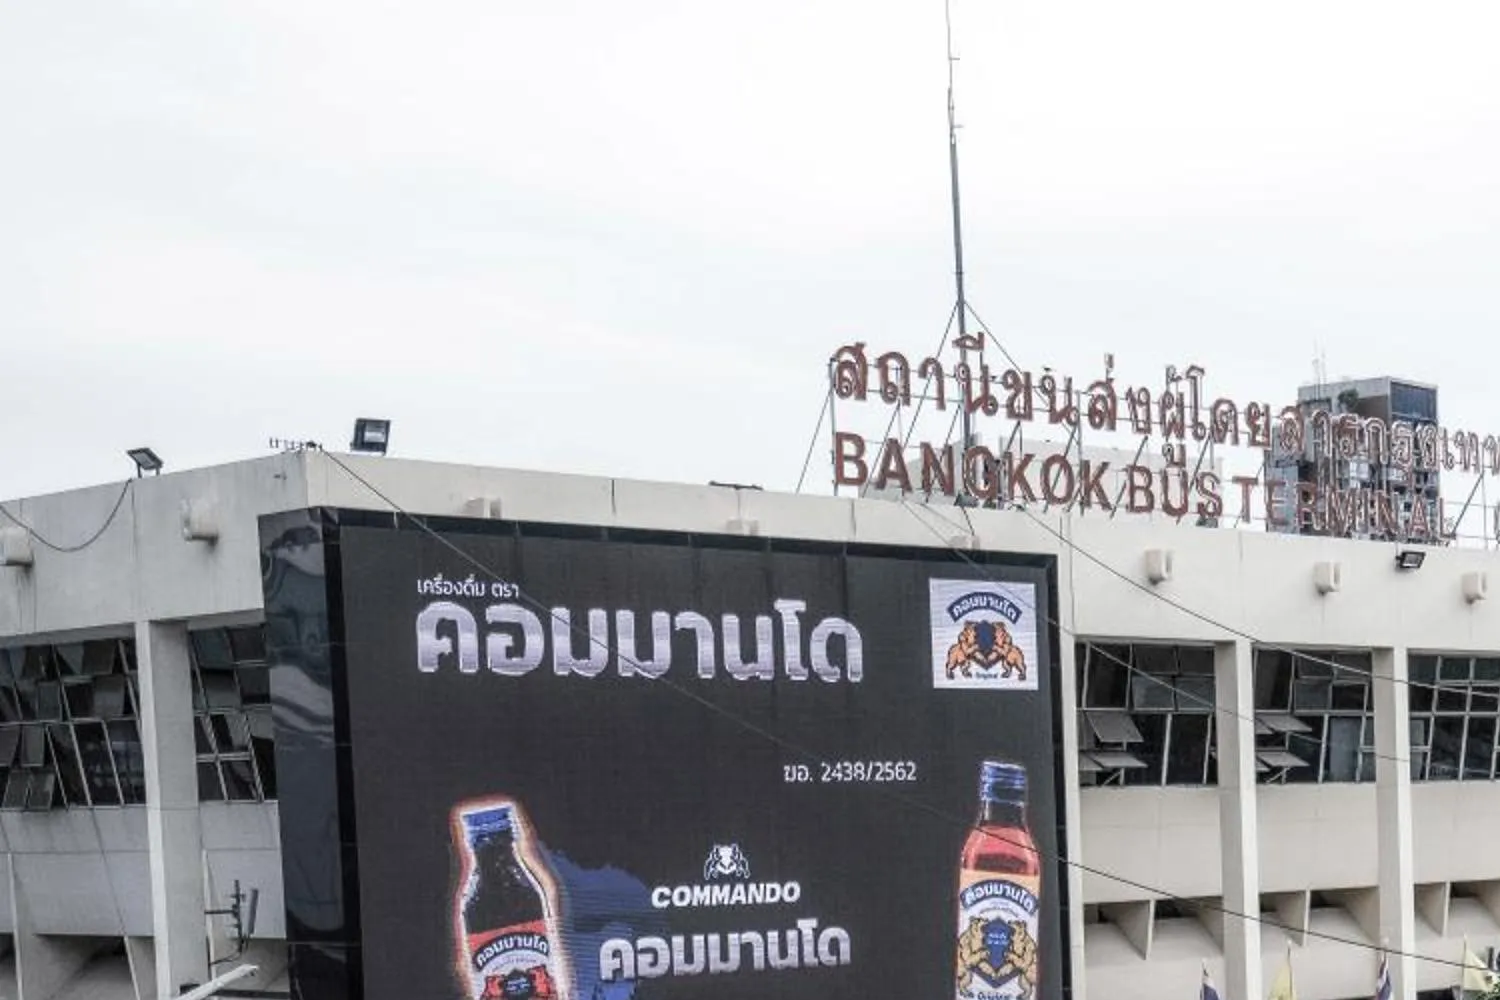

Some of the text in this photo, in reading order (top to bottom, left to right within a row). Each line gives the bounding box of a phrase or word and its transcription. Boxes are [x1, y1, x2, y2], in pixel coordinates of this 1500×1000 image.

[834, 432, 1112, 516] BANGKOK
[1125, 465, 1223, 516] BUS
[1231, 476, 1455, 541] TERMINAL
[418, 574, 520, 598] เครื่องดื่ม ตรา
[416, 598, 863, 682] คอมมานโด
[821, 761, 917, 782] 2438/2562
[651, 882, 800, 909] COMMANDO
[600, 918, 850, 980] คอมมานโด
